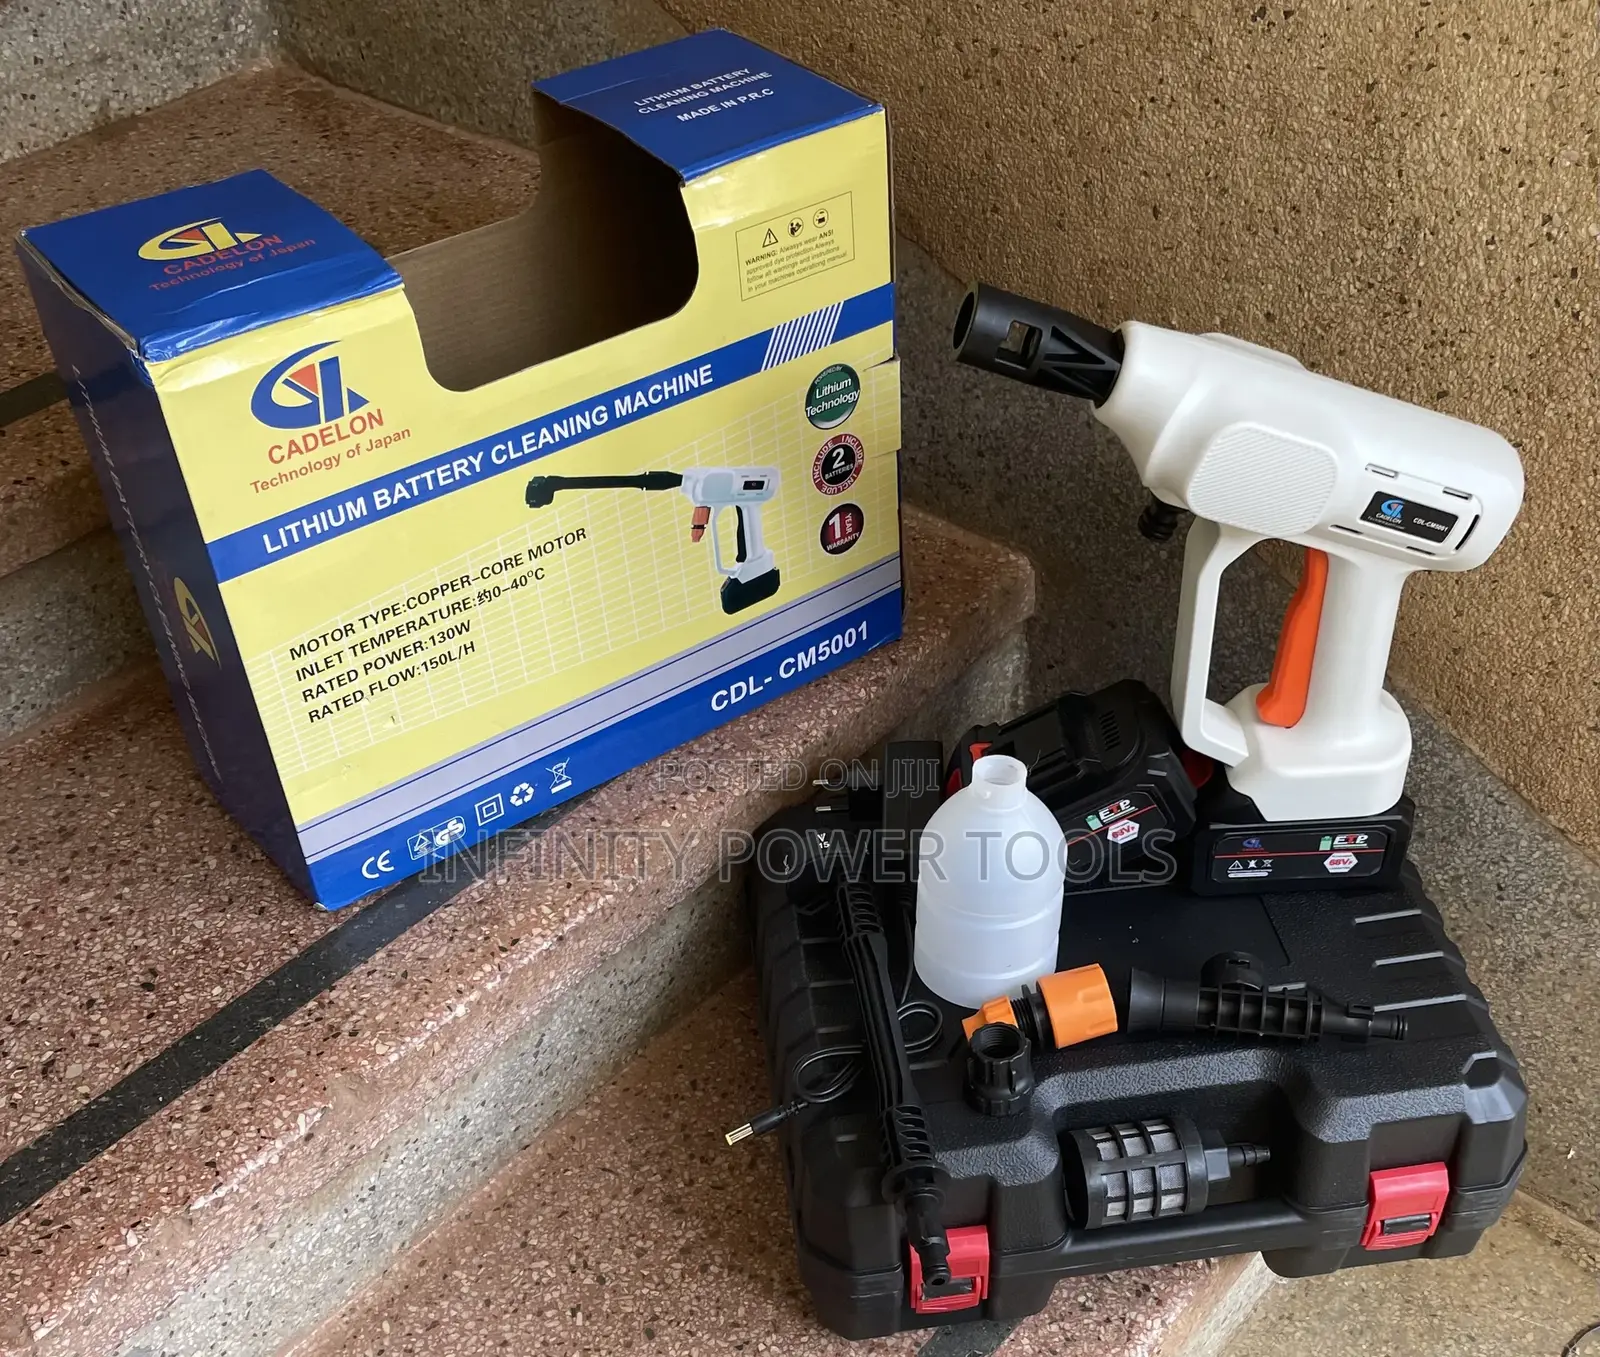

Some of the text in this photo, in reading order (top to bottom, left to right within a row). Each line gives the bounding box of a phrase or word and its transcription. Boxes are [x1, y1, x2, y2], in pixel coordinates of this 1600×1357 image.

[634, 68, 751, 106] LITHIUM BATTERY
[638, 71, 773, 114] CLEANING MACHINE
[676, 88, 774, 122] MADE IN P.R.C
[149, 238, 316, 291] Technology of Japan
[163, 234, 284, 275] CADELON
[745, 250, 778, 266] WARNING:
[803, 235, 818, 246] wear
[819, 229, 834, 240] ANSI
[746, 261, 773, 276] approved
[746, 273, 764, 284] follow
[799, 255, 810, 265] and
[754, 280, 767, 291] your
[768, 271, 795, 285] machines
[806, 389, 860, 418] Technology
[815, 378, 852, 399] Lithium
[268, 408, 384, 465] CADELON
[841, 435, 863, 463] INCLUDE
[250, 428, 411, 494] Technology of Japan
[261, 363, 715, 555] LITHIUM BATTERY CLEANING MACHINE
[813, 440, 834, 484] INCLUDE
[825, 463, 854, 480] BATTERIES
[831, 447, 846, 470] 2
[821, 473, 858, 493] INCLUDE
[828, 513, 841, 540] 1
[844, 512, 853, 535] YEAR
[826, 531, 860, 551] WARRANTY
[289, 527, 587, 661] MOTOR TYPE:COPPER-CORE MOTOR
[295, 651, 344, 682] INLET
[301, 619, 473, 703] RATED POWER:130W
[778, 620, 868, 680] CM5001
[308, 640, 476, 724] RATED FLOW:150L/H
